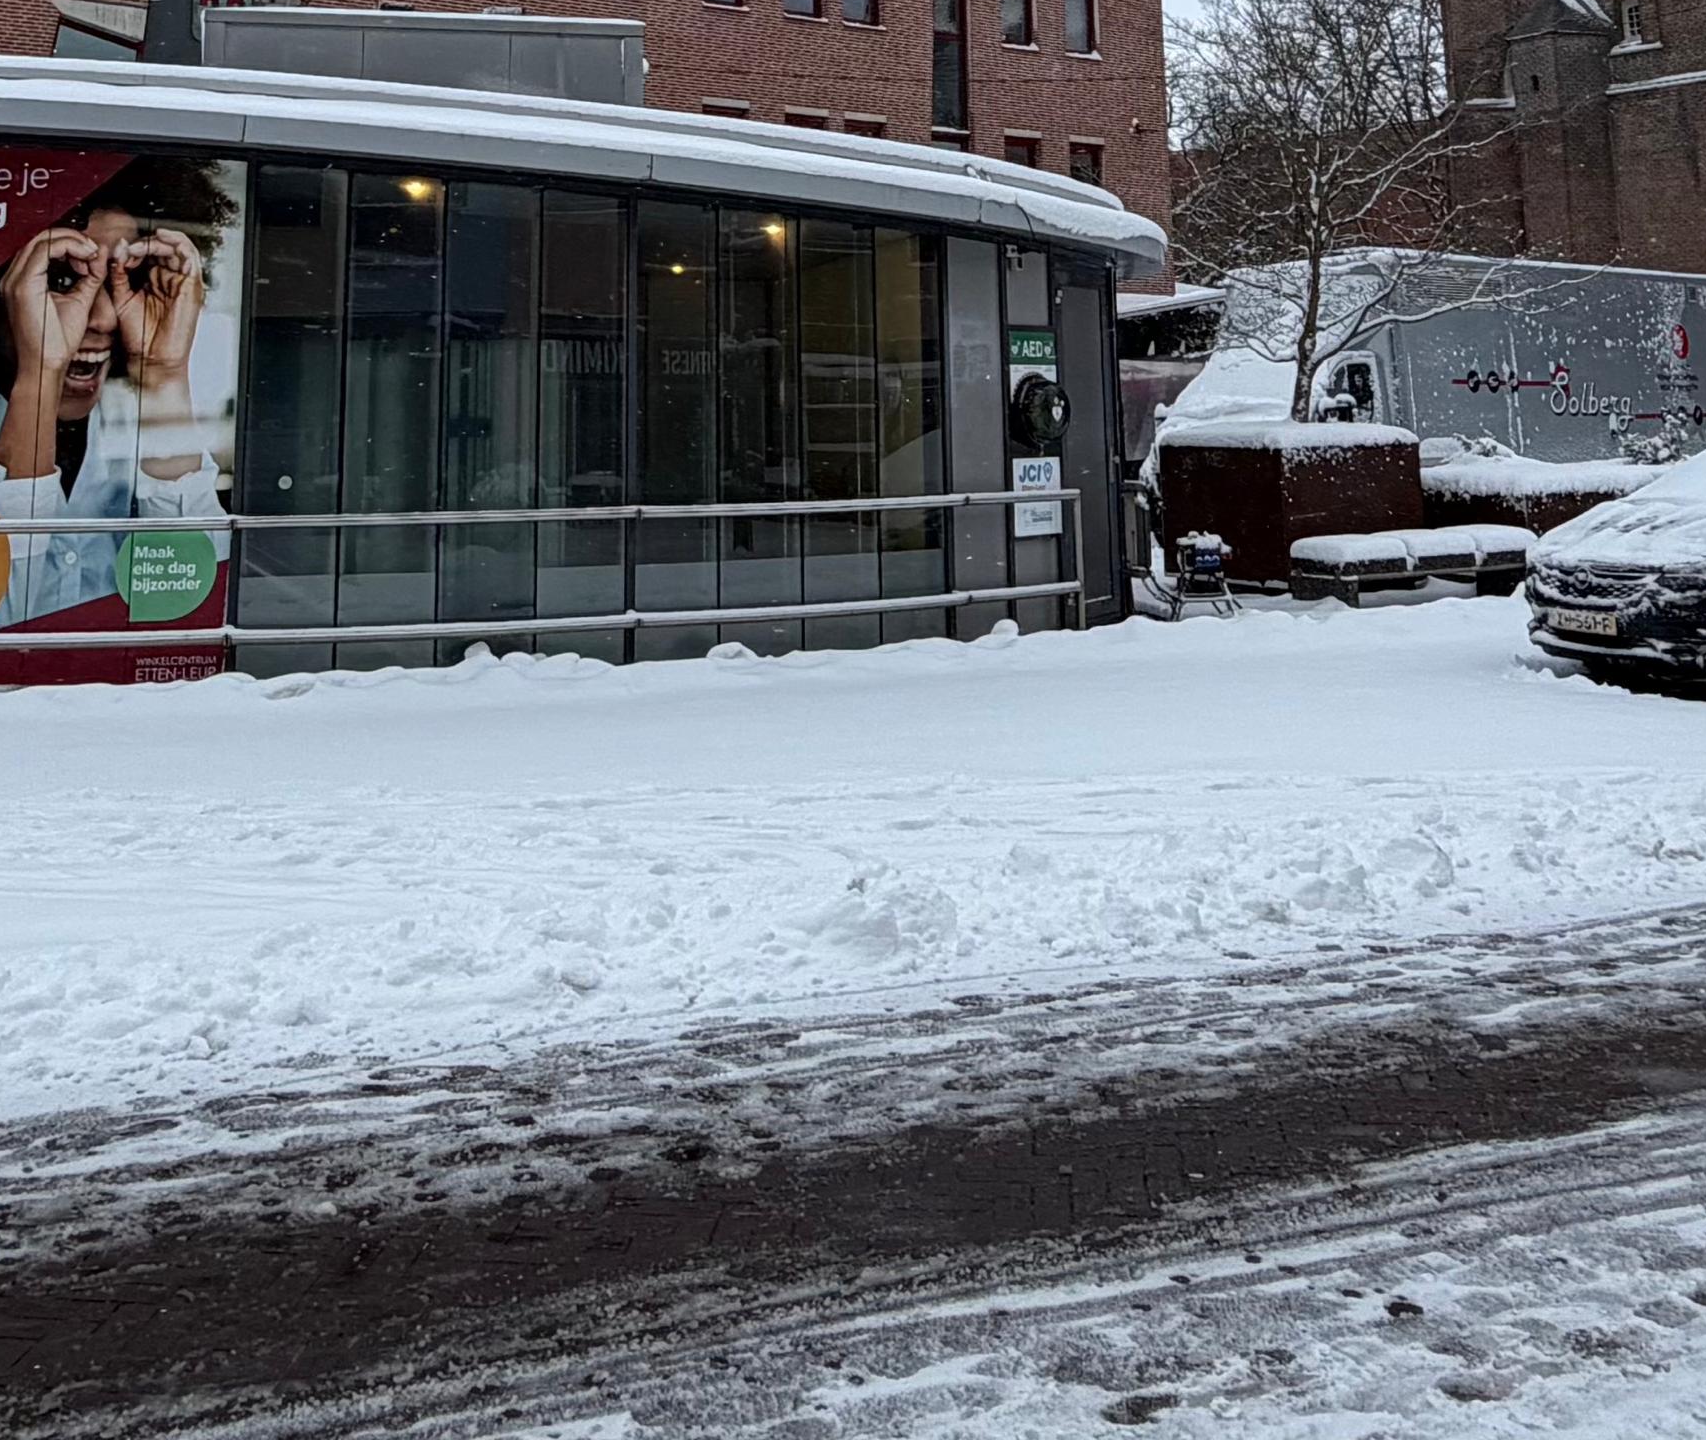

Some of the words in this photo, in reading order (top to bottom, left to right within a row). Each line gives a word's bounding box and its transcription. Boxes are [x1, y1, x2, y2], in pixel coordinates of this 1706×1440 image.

[16, 162, 50, 196] je
[1022, 340, 1043, 358] AED
[1550, 371, 1634, 433] Solberg
[1019, 463, 1042, 483] JCI
[134, 546, 175, 559] Maak
[133, 562, 164, 575] elke
[167, 561, 196, 577] dag
[132, 577, 202, 594] bijzonder
[135, 655, 217, 666] WINKELCENTRUM
